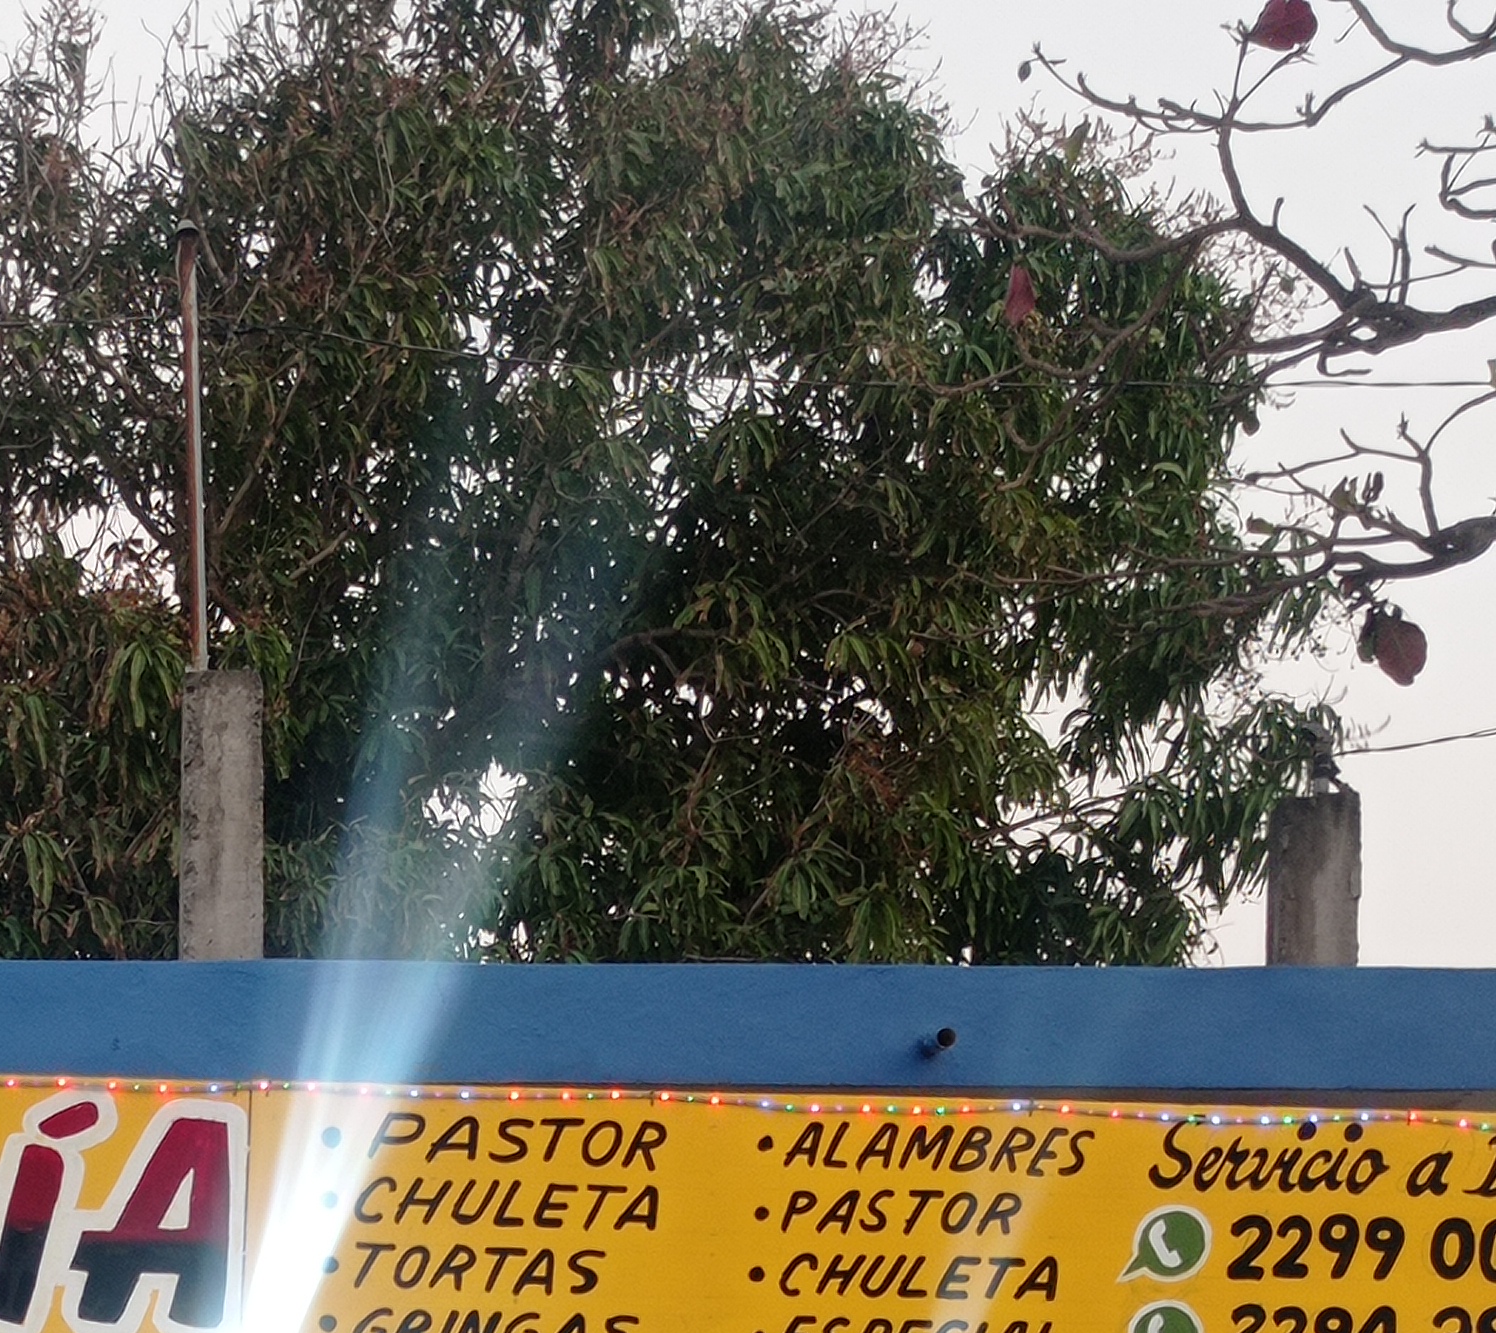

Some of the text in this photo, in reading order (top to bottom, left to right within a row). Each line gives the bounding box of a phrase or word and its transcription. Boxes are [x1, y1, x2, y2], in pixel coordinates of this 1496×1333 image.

[367, 1111, 668, 1171] PASTOR
[783, 1121, 1096, 1177] ALAMBRES
[1148, 1114, 1391, 1195] Servicio
[1405, 1150, 1454, 1198] a
[353, 1176, 661, 1231] CHULETA
[780, 1189, 1023, 1236] PASTOR
[353, 1241, 607, 1297] TORTAS
[1226, 1212, 1405, 1281] 2299
[778, 1252, 1059, 1301] CHULETA
